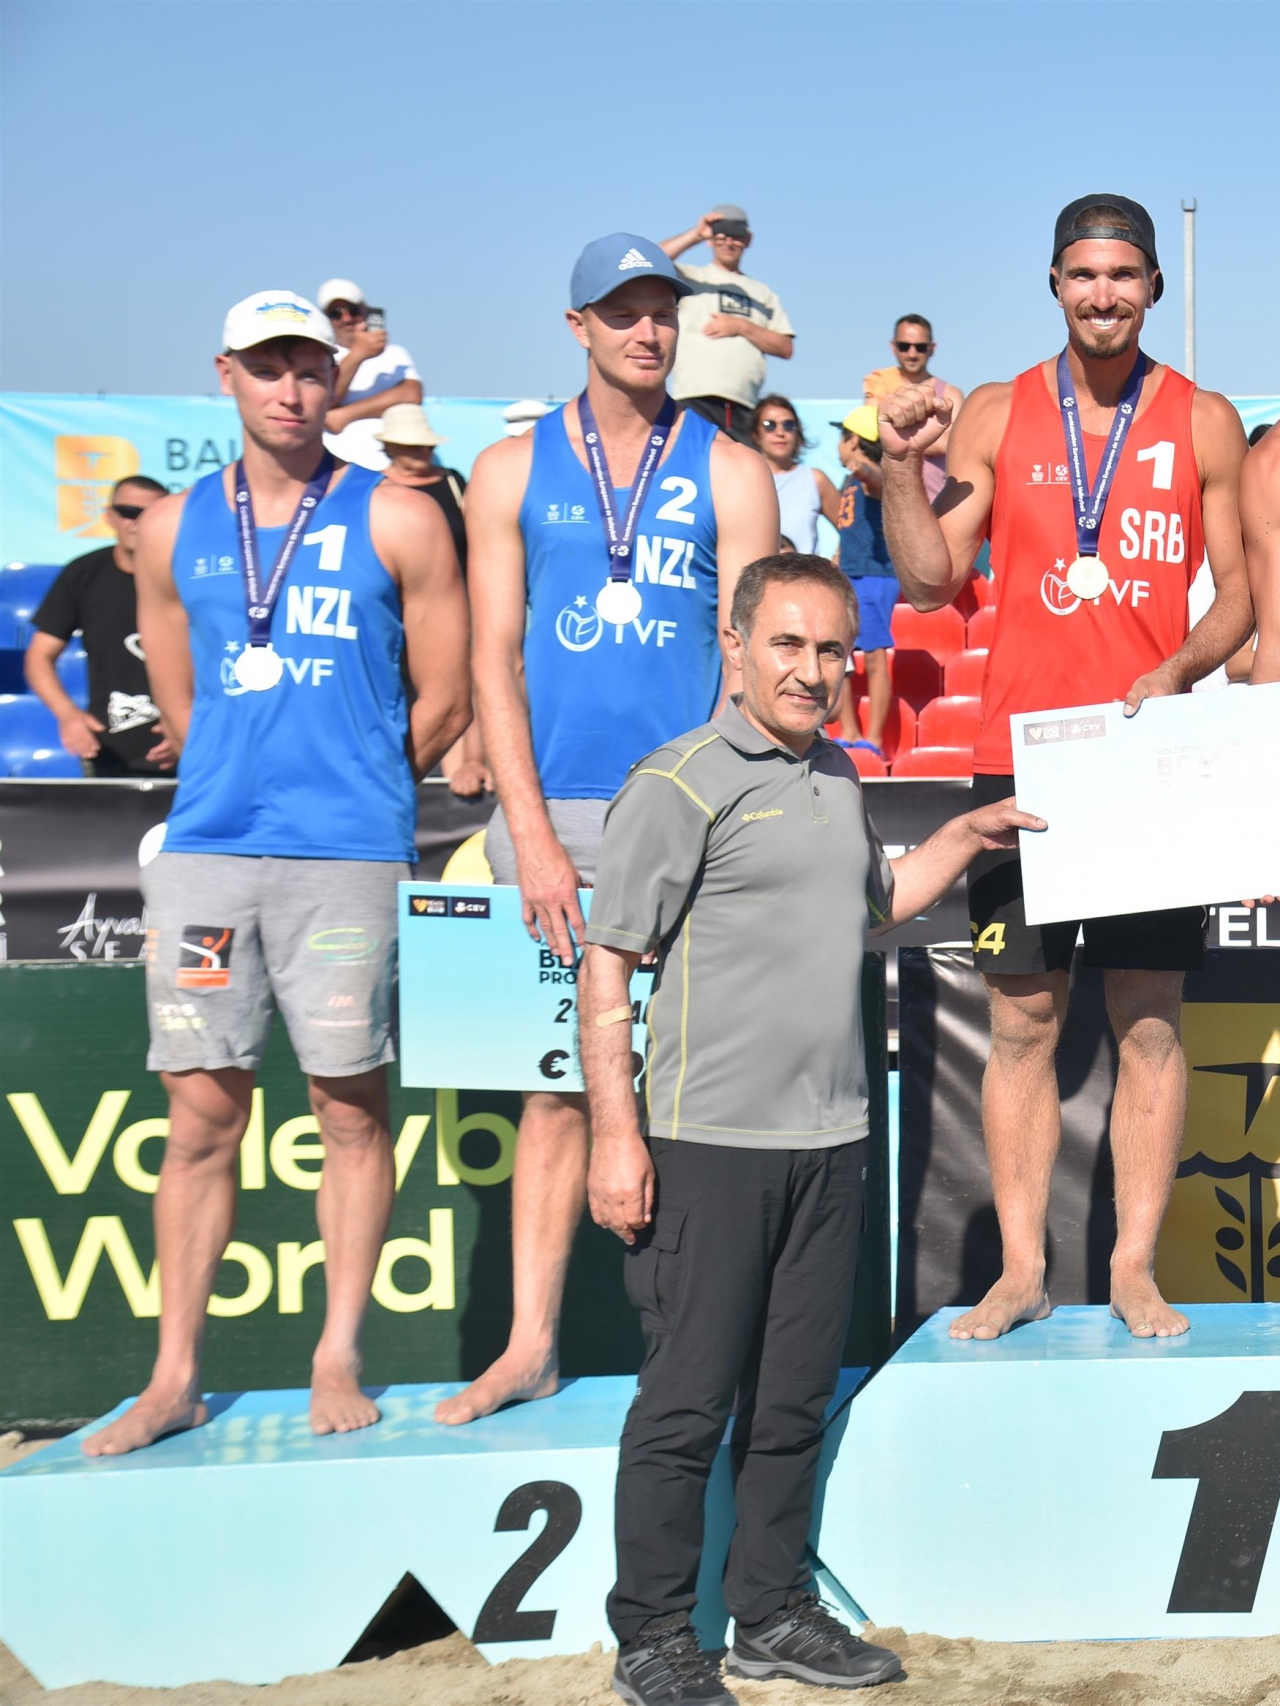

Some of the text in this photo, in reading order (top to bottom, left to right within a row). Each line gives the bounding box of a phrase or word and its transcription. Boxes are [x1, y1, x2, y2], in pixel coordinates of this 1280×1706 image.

[1137, 440, 1175, 490] 1
[655, 476, 698, 525] 2
[302, 524, 347, 572] 1
[635, 535, 697, 589] NZL
[1119, 507, 1185, 564] SRB
[285, 585, 358, 640] NZL
[750, 808, 784, 820] Columbia
[13, 1208, 456, 1321] Word
[471, 1480, 582, 1643] 2
